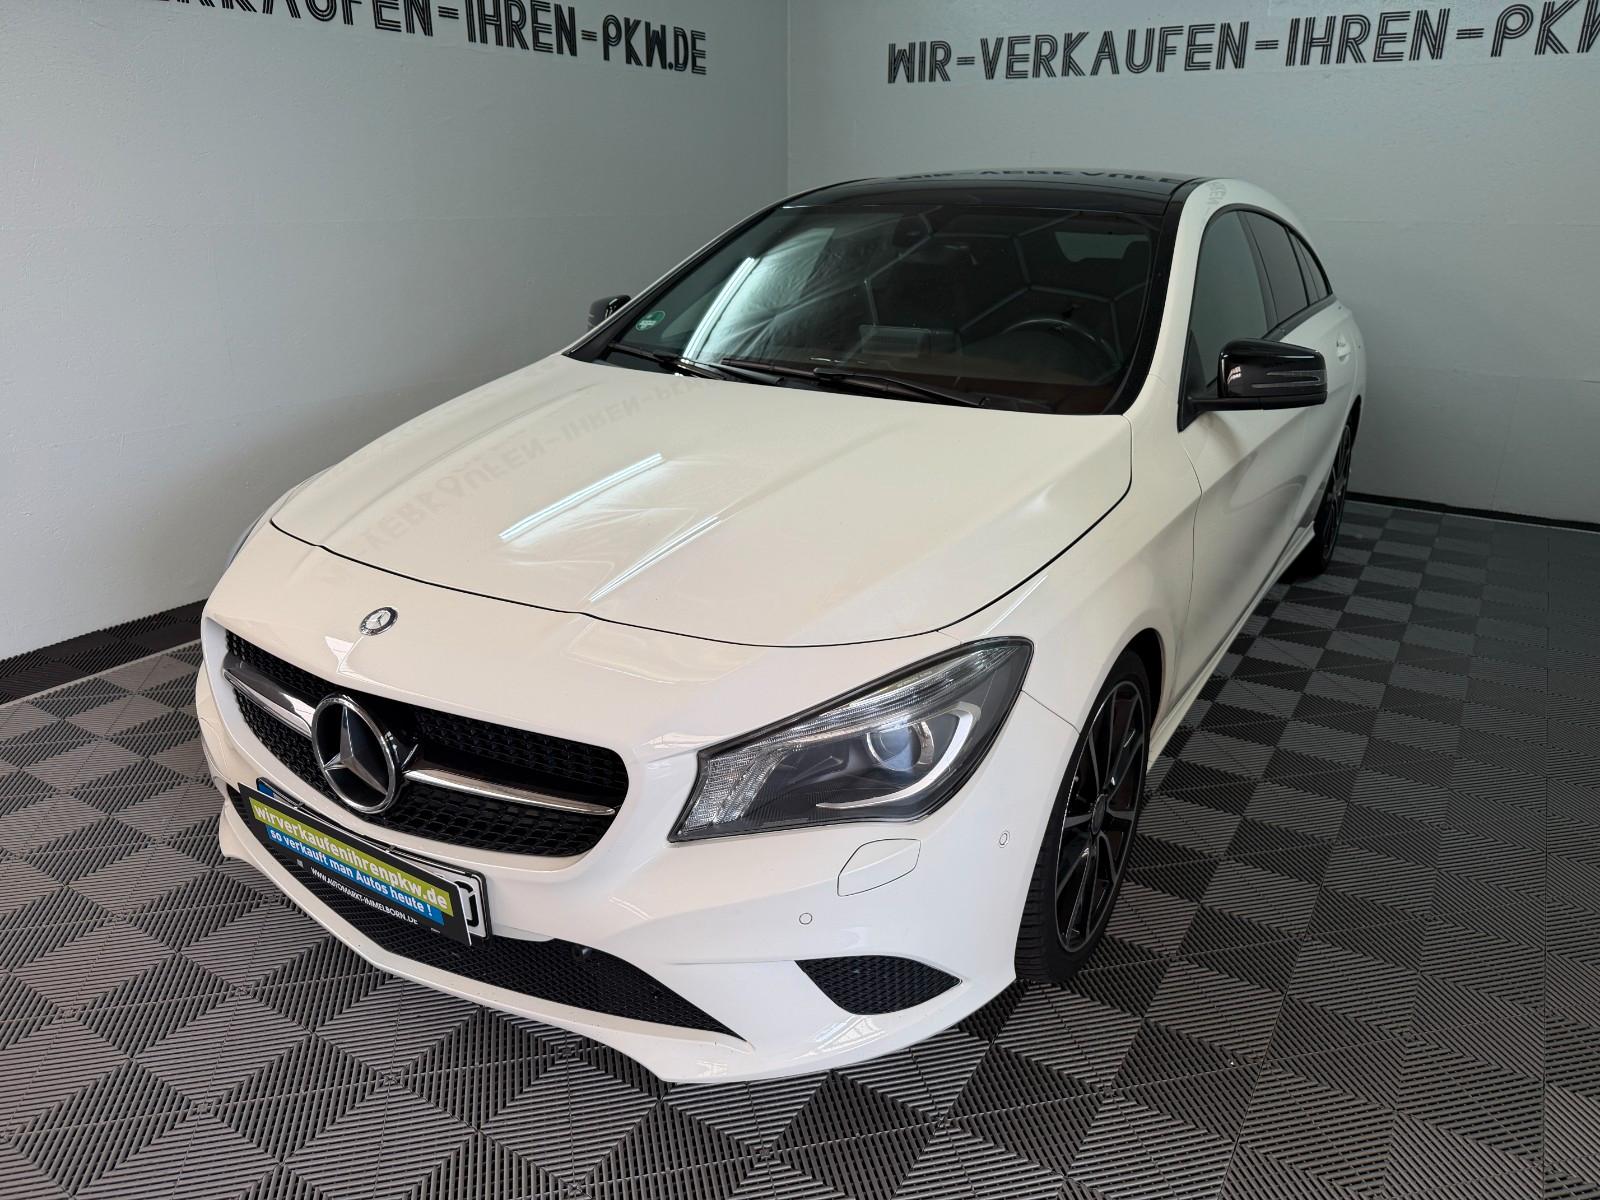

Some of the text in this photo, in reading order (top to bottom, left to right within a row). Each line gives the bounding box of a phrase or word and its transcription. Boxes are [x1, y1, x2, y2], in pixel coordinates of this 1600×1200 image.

[254, 805, 448, 910] wirverkaufenihrenpkw.de
[270, 829, 283, 842] so
[284, 835, 329, 866] verkauft
[329, 858, 354, 878] man
[356, 870, 388, 895] Autos
[389, 886, 424, 912] heute
